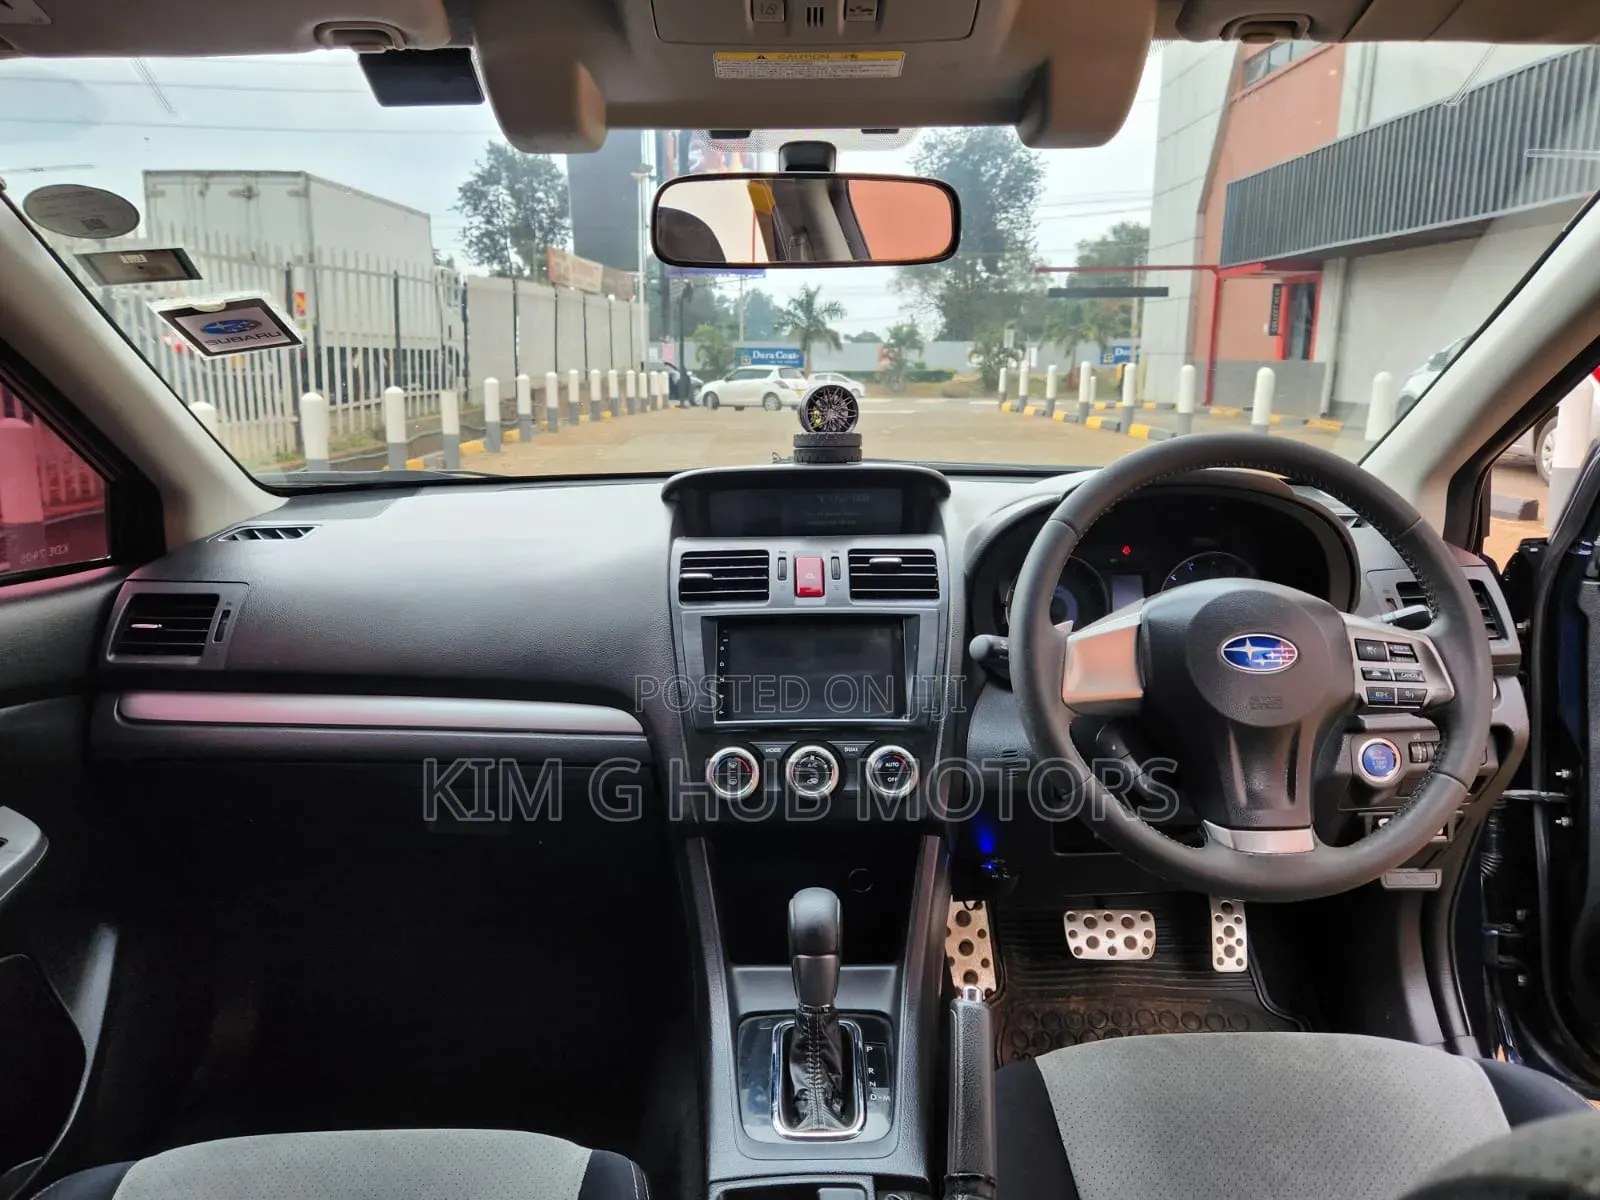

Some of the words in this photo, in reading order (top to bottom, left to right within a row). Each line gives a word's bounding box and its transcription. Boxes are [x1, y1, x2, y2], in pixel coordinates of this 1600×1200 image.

[204, 331, 282, 346] SUBARU
[868, 1067, 875, 1075] R
[870, 1080, 877, 1088] N
